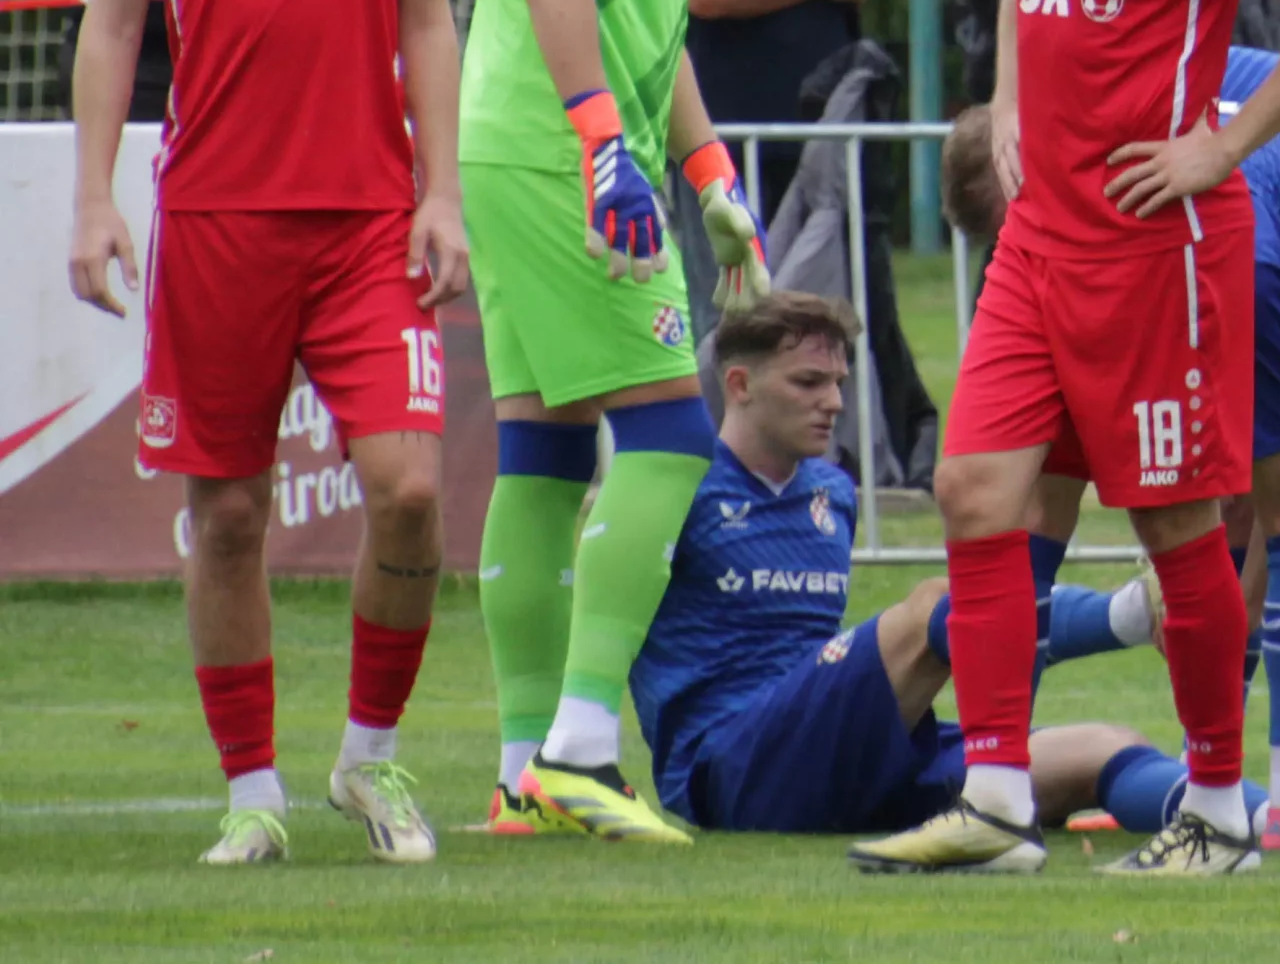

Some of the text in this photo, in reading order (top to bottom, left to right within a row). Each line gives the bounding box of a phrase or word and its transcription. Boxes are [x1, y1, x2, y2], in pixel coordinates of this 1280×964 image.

[401, 327, 441, 397] 16
[1133, 399, 1184, 469] 18
[1139, 469, 1178, 486] JAKO
